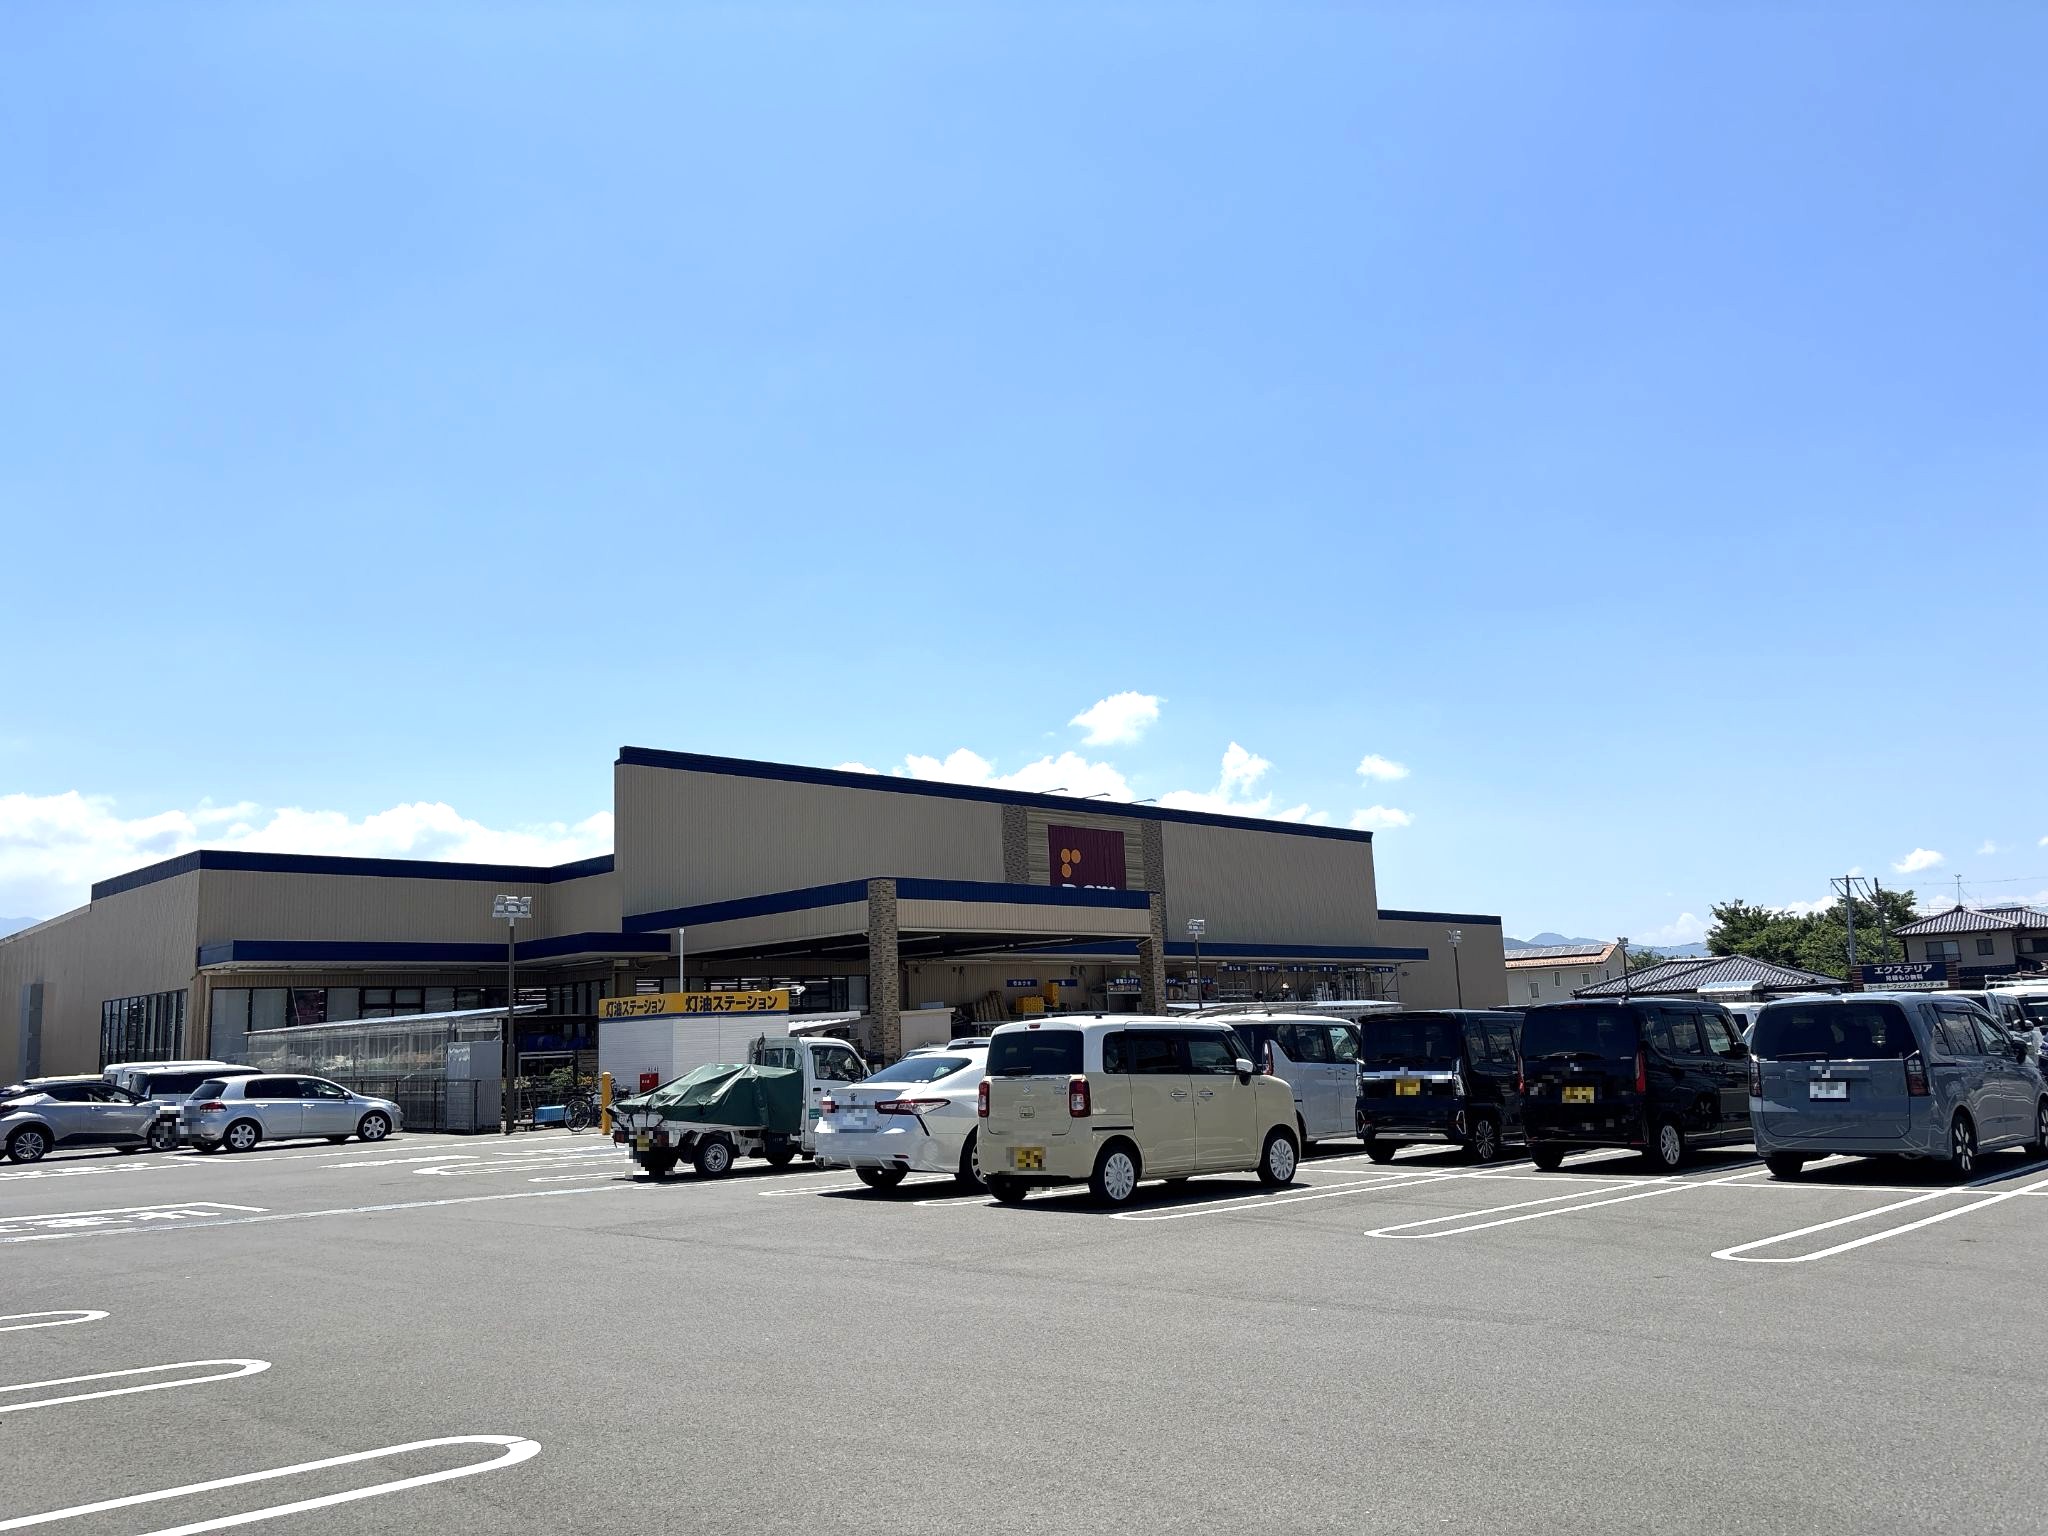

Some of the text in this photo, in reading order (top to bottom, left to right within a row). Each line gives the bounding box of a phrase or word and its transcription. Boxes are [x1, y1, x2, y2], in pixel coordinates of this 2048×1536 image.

[1874, 964, 1932, 974] エクステリア
[605, 998, 666, 1018] 灯油ステーション
[685, 995, 778, 1012] 灯油ステーション
